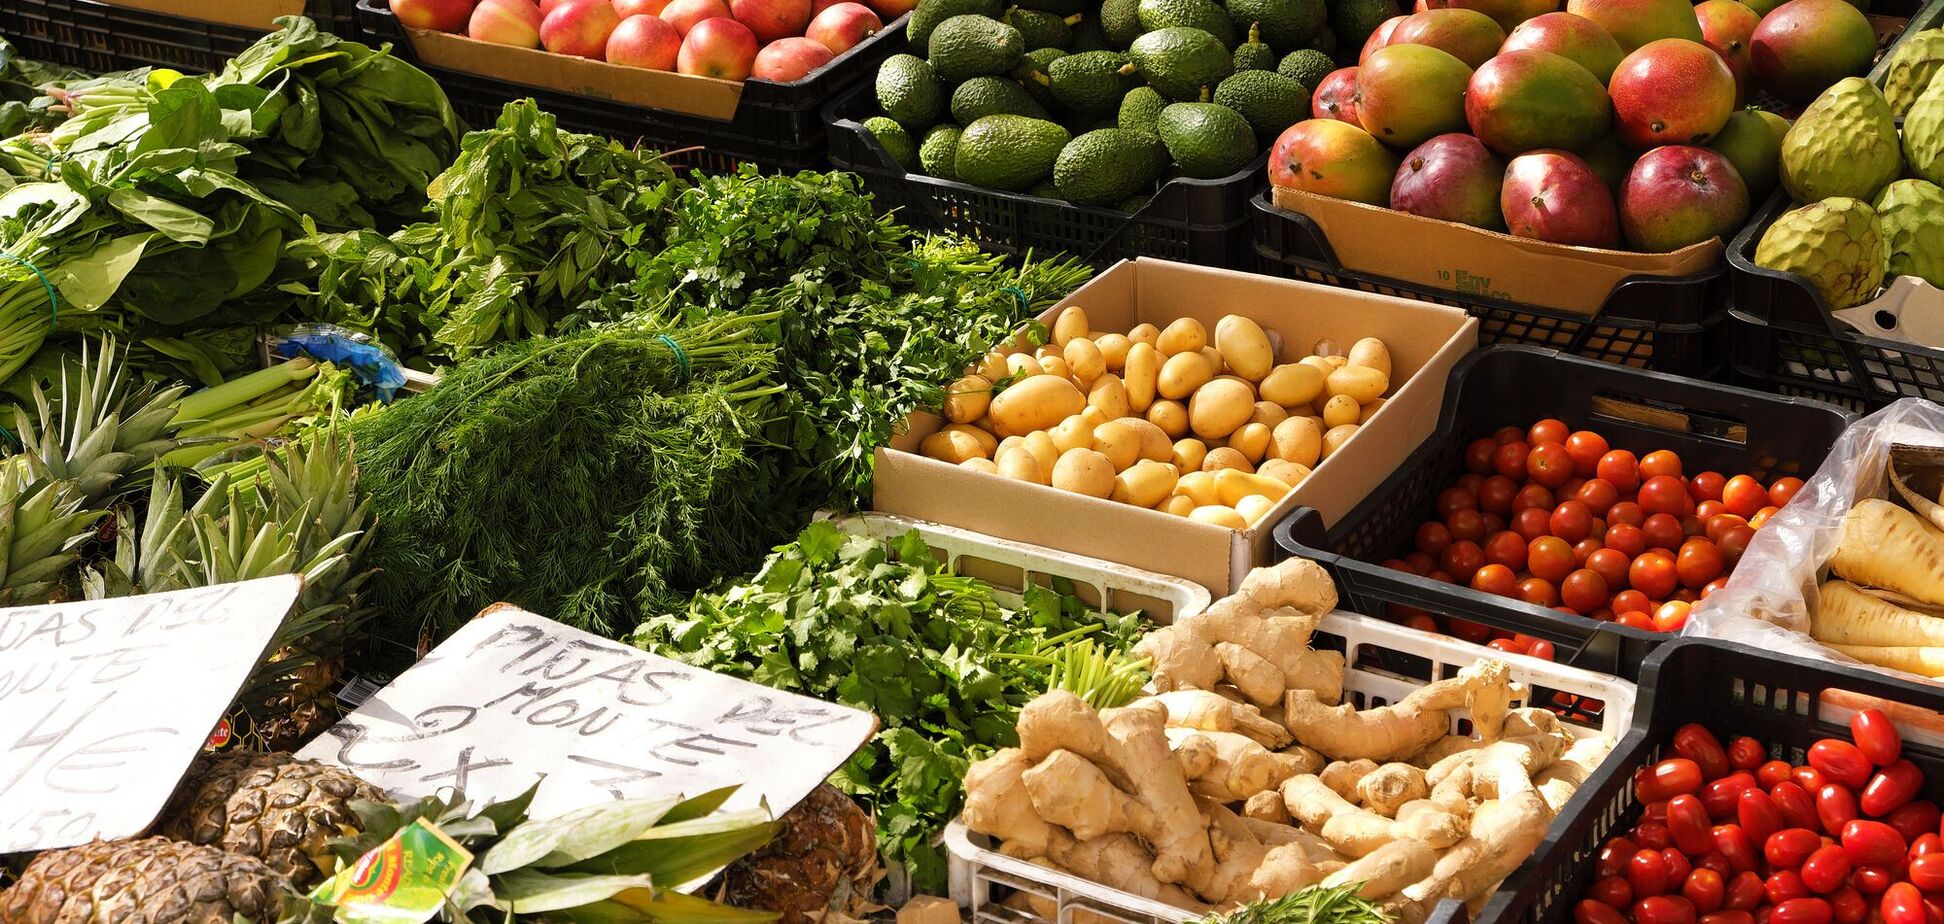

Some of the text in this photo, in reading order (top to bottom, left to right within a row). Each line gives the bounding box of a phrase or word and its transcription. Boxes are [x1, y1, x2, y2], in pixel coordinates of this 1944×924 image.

[1437, 269, 1450, 281] 10
[484, 680, 758, 767] MONTE
[715, 697, 852, 746] DEL
